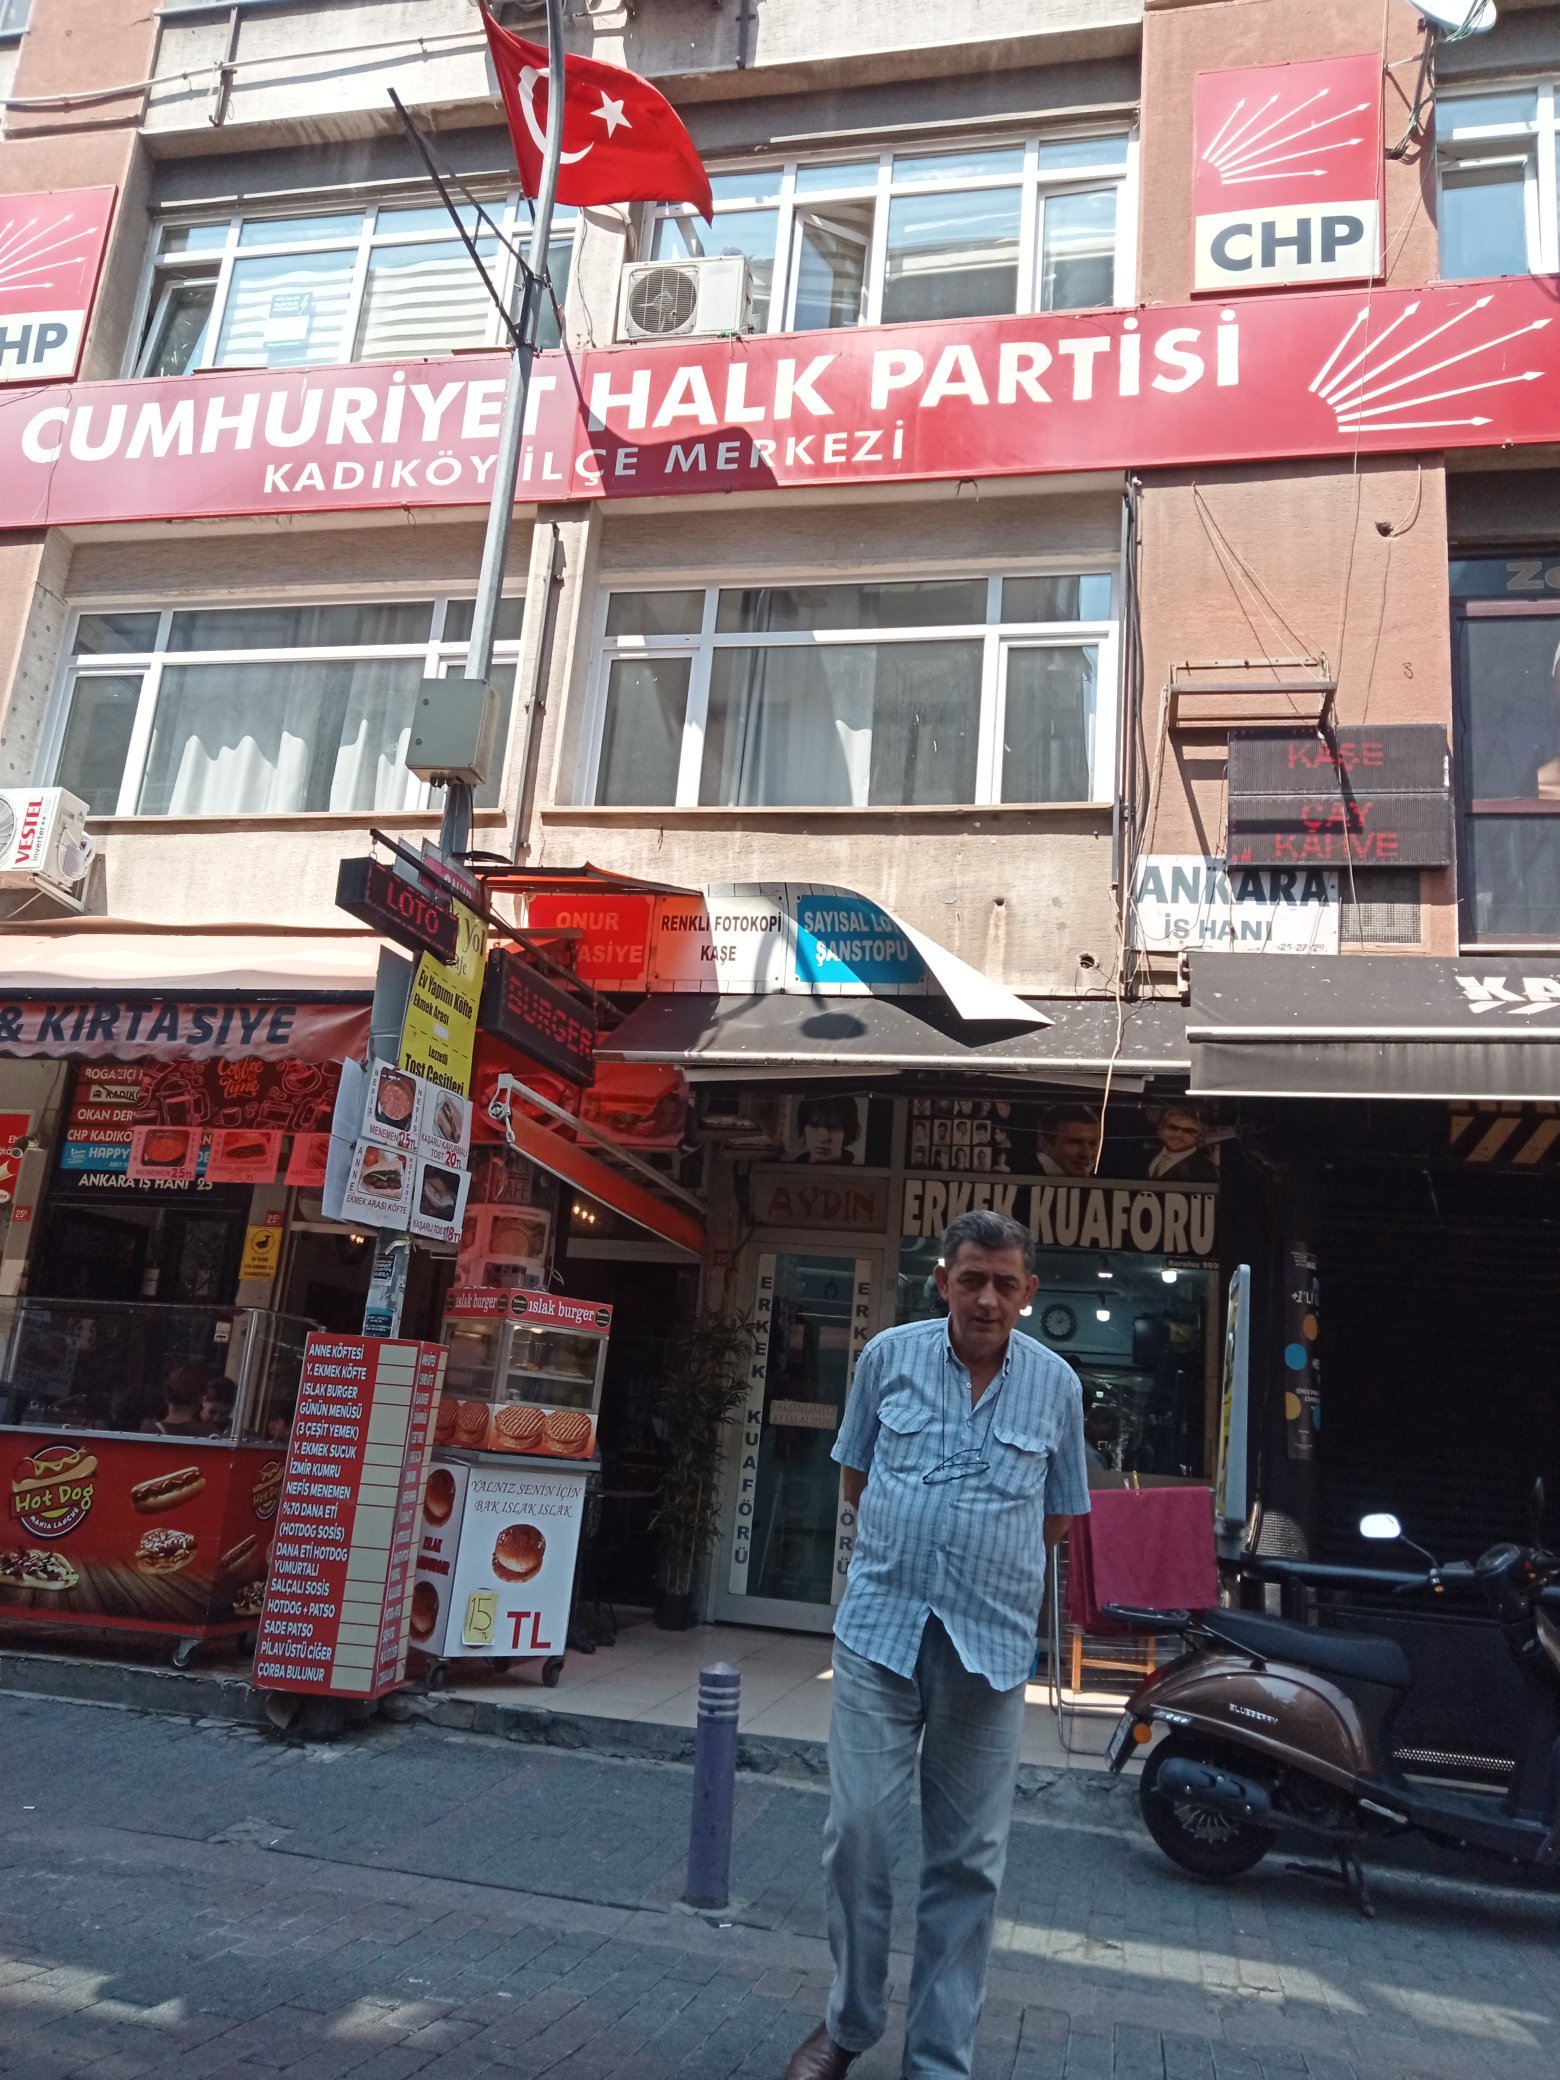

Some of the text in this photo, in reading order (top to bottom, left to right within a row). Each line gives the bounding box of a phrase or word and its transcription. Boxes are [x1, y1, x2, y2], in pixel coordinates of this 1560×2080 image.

[1210, 215, 1365, 272] CHP
[21, 310, 1239, 464] CUMHURİYET HALK PARTİSİ
[263, 420, 904, 494] KADIKÖY İLÇE MERKEZİ
[1287, 743, 1385, 772] KAŞE
[1302, 802, 1374, 833] ÇAY
[15, 796, 44, 864] VESTEL
[1275, 832, 1399, 860] KAHVE
[1138, 865, 1330, 907] ANKARA
[387, 881, 439, 934] LOTO
[556, 911, 620, 931] ONUR
[661, 911, 782, 932] RENKLİ FOTOKOPİ
[804, 911, 867, 932] SAYISAL
[1199, 920, 1273, 941] HANI
[576, 940, 643, 963] ASİYE
[701, 945, 737, 965] KAŞE
[815, 940, 908, 966] ŞANSTOPU
[418, 969, 473, 1019] Ev Yapımı Köfte
[413, 993, 449, 1026] Ekmek Arası
[507, 976, 592, 1061] BURGER
[405, 1052, 425, 1078] Tost
[428, 1045, 448, 1066] Lezzetli
[77, 1109, 111, 1121] OKAN
[66, 1129, 89, 1141] CHP
[369, 1124, 399, 1143] MENEMEN
[420, 1133, 440, 1148] KAŞARLI
[88, 1146, 130, 1160] HAPPY
[431, 1149, 445, 1161] TOST
[349, 1146, 363, 1191] ANNE
[78, 1173, 136, 1188] ANKARA
[155, 1178, 190, 1190] HANI
[346, 1194, 408, 1215] EKMEK ARASI KÖFTE
[768, 1186, 876, 1222] AYDIN
[412, 1220, 433, 1233] KAŞARLI
[1029, 1184, 1216, 1256] KUAFÖRÜ
[472, 1294, 498, 1312] burger
[558, 1302, 595, 1324] burger
[752, 1276, 773, 1379] ERKEK
[851, 1282, 870, 1382] ERK
[308, 1342, 364, 1360] ANNE KÖFTESİ
[313, 1364, 341, 1378] EKMEK
[342, 1362, 367, 1380] KÖFTE
[302, 1382, 358, 1399] ISLAK BURGER
[300, 1401, 363, 1419] GÜNÜN MENÜSÜ
[305, 1419, 328, 1439] ÇEŞİT
[329, 1425, 360, 1441] YEMEK)
[300, 1442, 328, 1457] EKMEK
[329, 1444, 357, 1460] SUCUK
[289, 1457, 341, 1478] İZMİR KUMRU
[15, 1483, 95, 1513] Hot Dog
[286, 1478, 351, 1500] NEFİS MENEMEN
[471, 1480, 582, 1501] YALNIZ SENİN İÇİN
[734, 1410, 762, 1565] KUAFÖRÜ
[301, 1503, 324, 1518] DANA
[324, 1502, 338, 1519] ETİ
[474, 1500, 573, 1518] BAK ISLAK ISLAK
[279, 1522, 345, 1542] (HOTDOG SOSİS)
[276, 1541, 348, 1562] DANA ETİ HOTDOG
[274, 1559, 319, 1577] YUMURTALI
[270, 1578, 330, 1597] SALÇALI SOSİS
[267, 1599, 302, 1615] HOTDOG
[308, 1602, 336, 1618] PATSO
[468, 1597, 492, 1632] 15
[264, 1620, 313, 1637] SADE PATSO
[506, 1611, 551, 1650] TL
[260, 1637, 285, 1655] PİLAV
[285, 1638, 307, 1659] ÜSTÜ
[257, 1662, 325, 1682] ÇORBA BULUNUR
